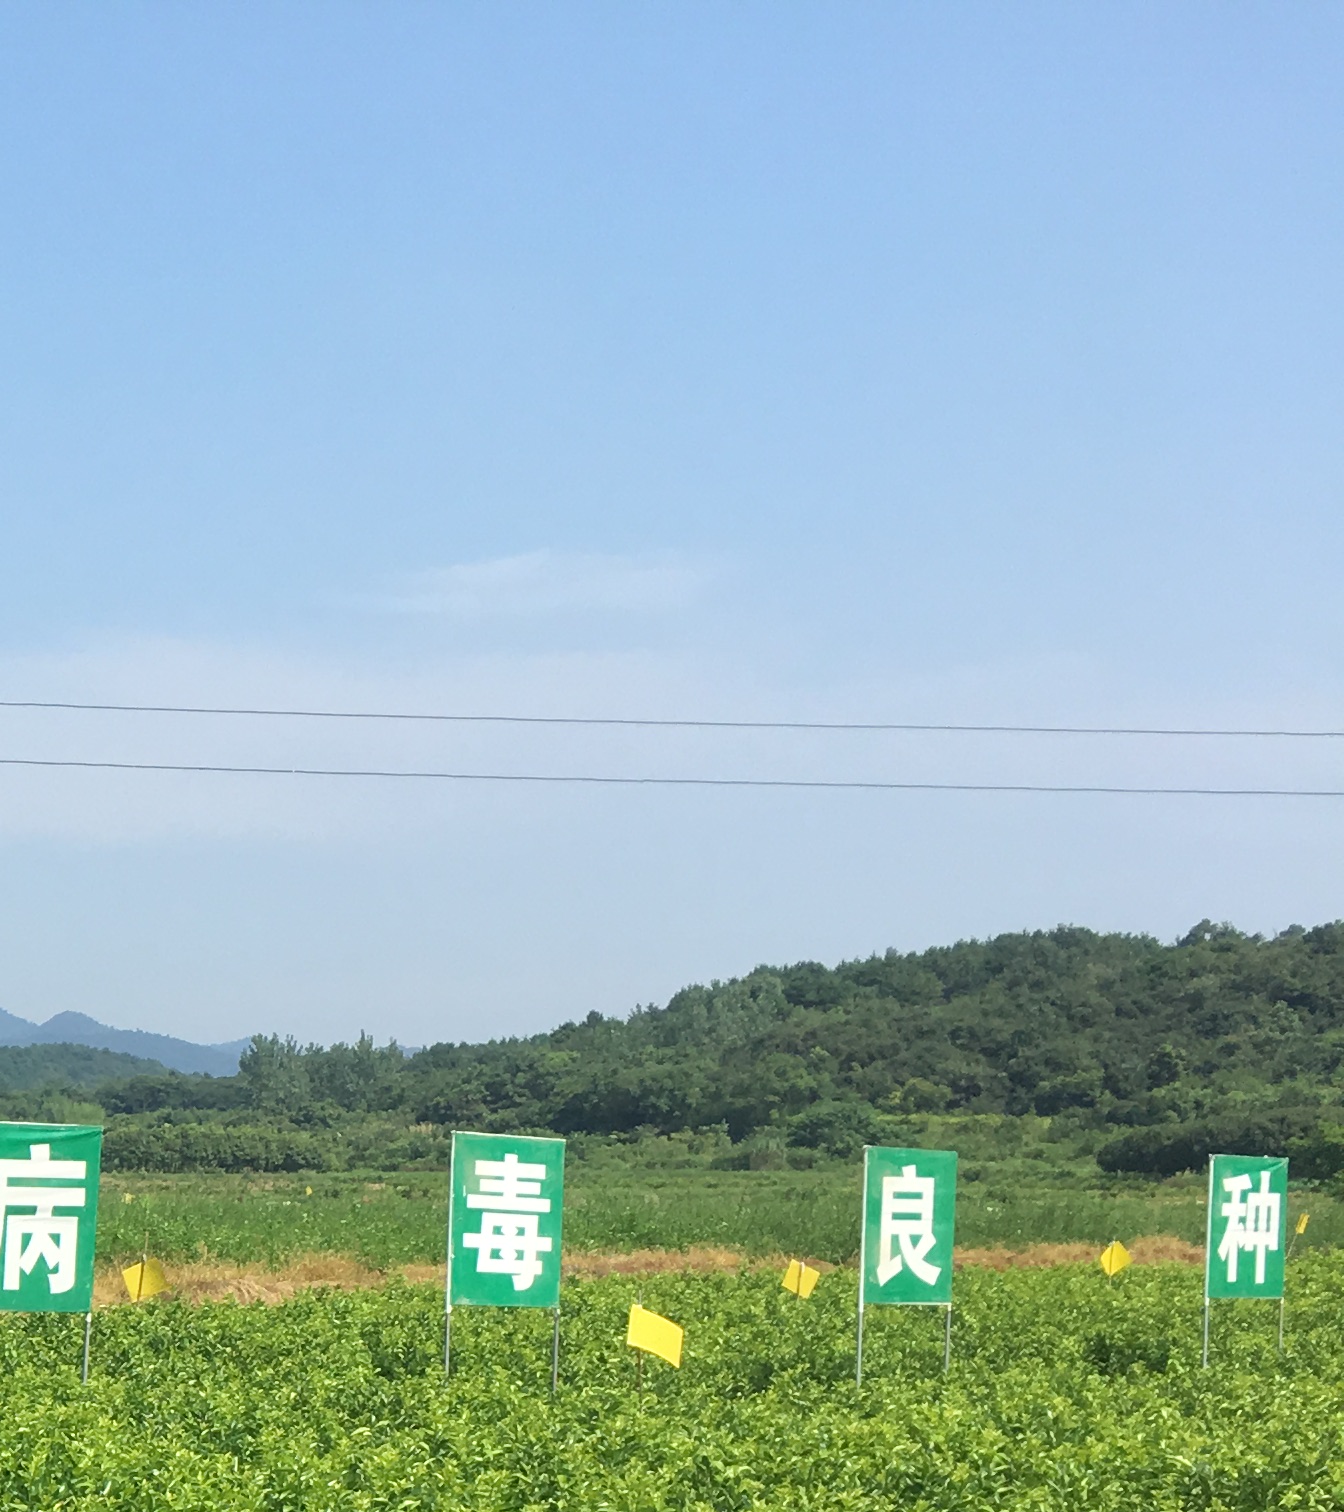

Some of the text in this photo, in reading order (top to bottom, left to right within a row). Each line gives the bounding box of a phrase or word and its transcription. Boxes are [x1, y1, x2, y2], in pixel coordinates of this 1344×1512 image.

[462, 1153, 553, 1291] 毒
[876, 1164, 942, 1287] 良
[1217, 1170, 1281, 1284] 种
